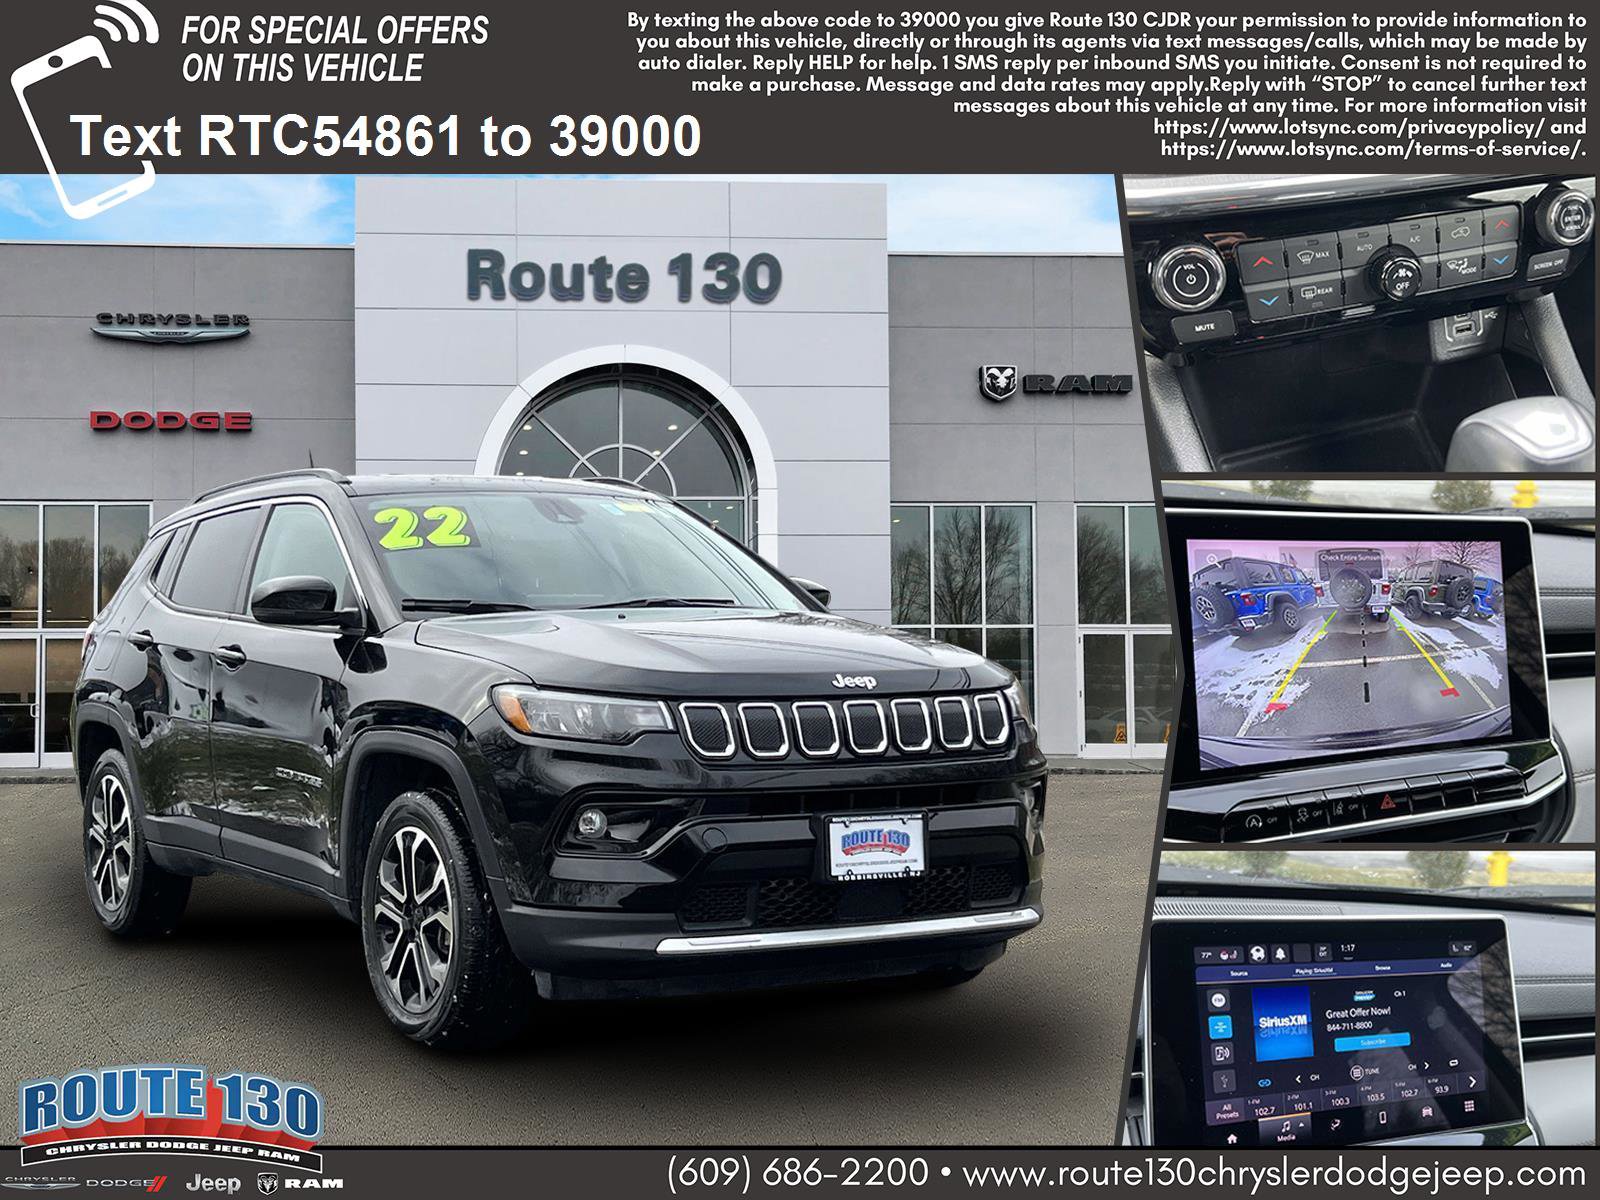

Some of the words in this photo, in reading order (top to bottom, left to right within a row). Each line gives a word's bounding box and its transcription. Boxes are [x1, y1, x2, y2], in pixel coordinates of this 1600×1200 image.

[1356, 243, 1373, 252] AUTO
[1461, 266, 1477, 275] MODE
[467, 248, 650, 303] Route
[668, 251, 782, 305] 130
[1317, 286, 1333, 295] REAR
[1395, 281, 1410, 291] OFF
[96, 312, 250, 326] CHRYSLER
[1195, 323, 1215, 332] MUTE
[1023, 374, 1133, 394] RAM
[90, 410, 252, 432] DODGE
[374, 506, 471, 551] 22
[831, 673, 878, 690] Jeep
[841, 828, 884, 849] ROUTE
[886, 829, 911, 848] 130
[1341, 944, 1355, 952] 1:17
[1325, 1008, 1349, 1019] Great
[1350, 1007, 1369, 1018] Offer
[1370, 1006, 1391, 1016] Now!
[1259, 1014, 1308, 1028] SiriusXM
[1326, 1020, 1373, 1032] 844-711-8800
[1360, 1038, 1386, 1047] Subscribe
[1365, 1067, 1380, 1076] TUNE
[1310, 1073, 1320, 1081] CH
[1401, 1089, 1419, 1098] 102.7
[1434, 1085, 1450, 1094] 93.9
[1331, 1097, 1350, 1107] 100.3
[1367, 1092, 1385, 1102] 103.5
[1222, 1103, 1232, 1111] All
[1254, 1106, 1276, 1117] 102.7
[1294, 1102, 1313, 1111] 101.1
[1216, 1111, 1240, 1120] Presets
[1277, 1133, 1296, 1143] Media
